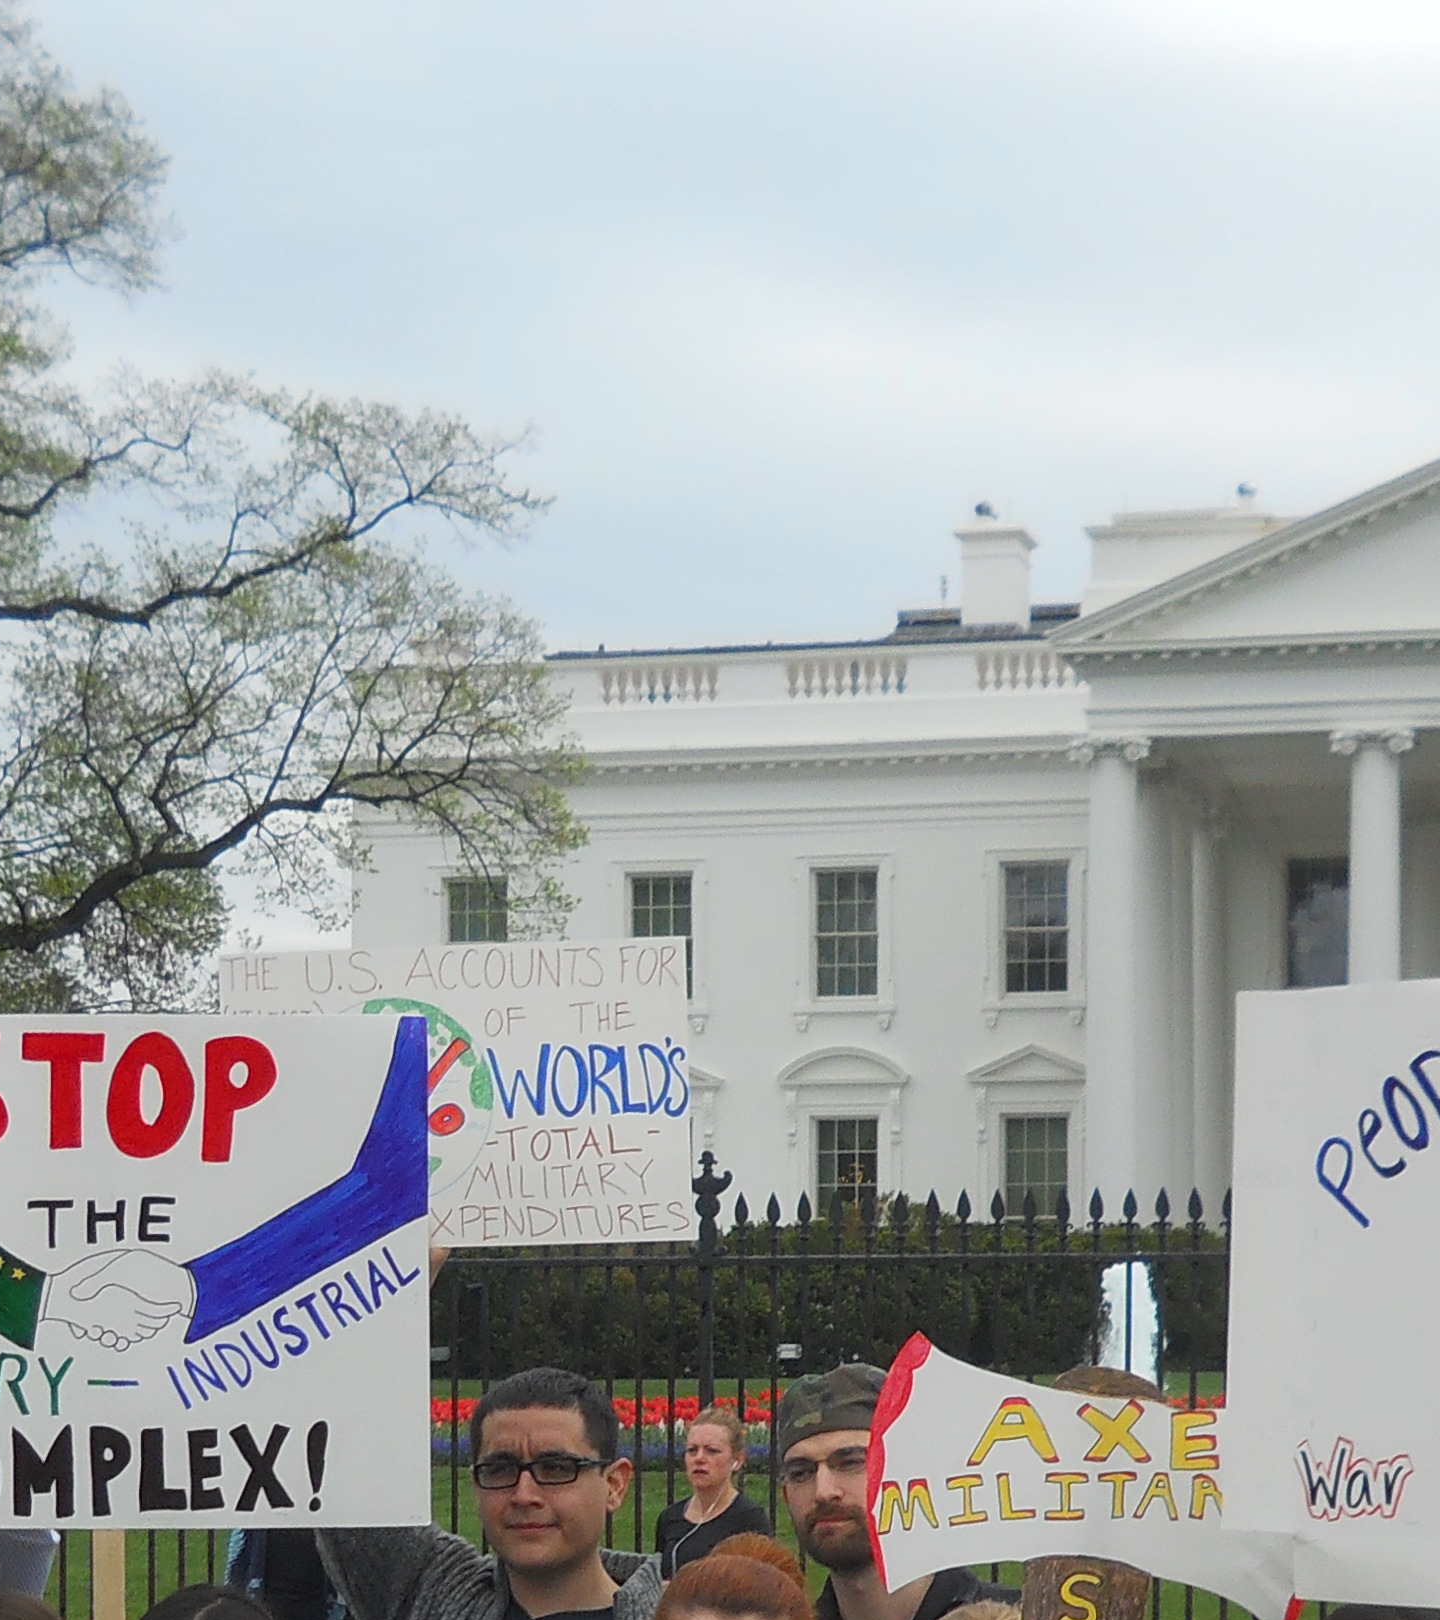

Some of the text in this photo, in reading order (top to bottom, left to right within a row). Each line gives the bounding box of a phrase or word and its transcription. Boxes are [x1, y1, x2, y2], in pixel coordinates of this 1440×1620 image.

[220, 945, 681, 994] THE U.S. ACCOUNTS FOR
[484, 1001, 637, 1037] OF THE
[486, 1036, 691, 1119] WORLD'S
[464, 1158, 655, 1200] MILITARY
[27, 1196, 177, 1249] THE
[430, 1201, 691, 1242] XPENDITURES
[165, 1245, 421, 1411] INDUSTRIAL
[966, 1396, 1221, 1471] AXE
[876, 1471, 1225, 1535] MILITAR
[1294, 1436, 1413, 1522] War
